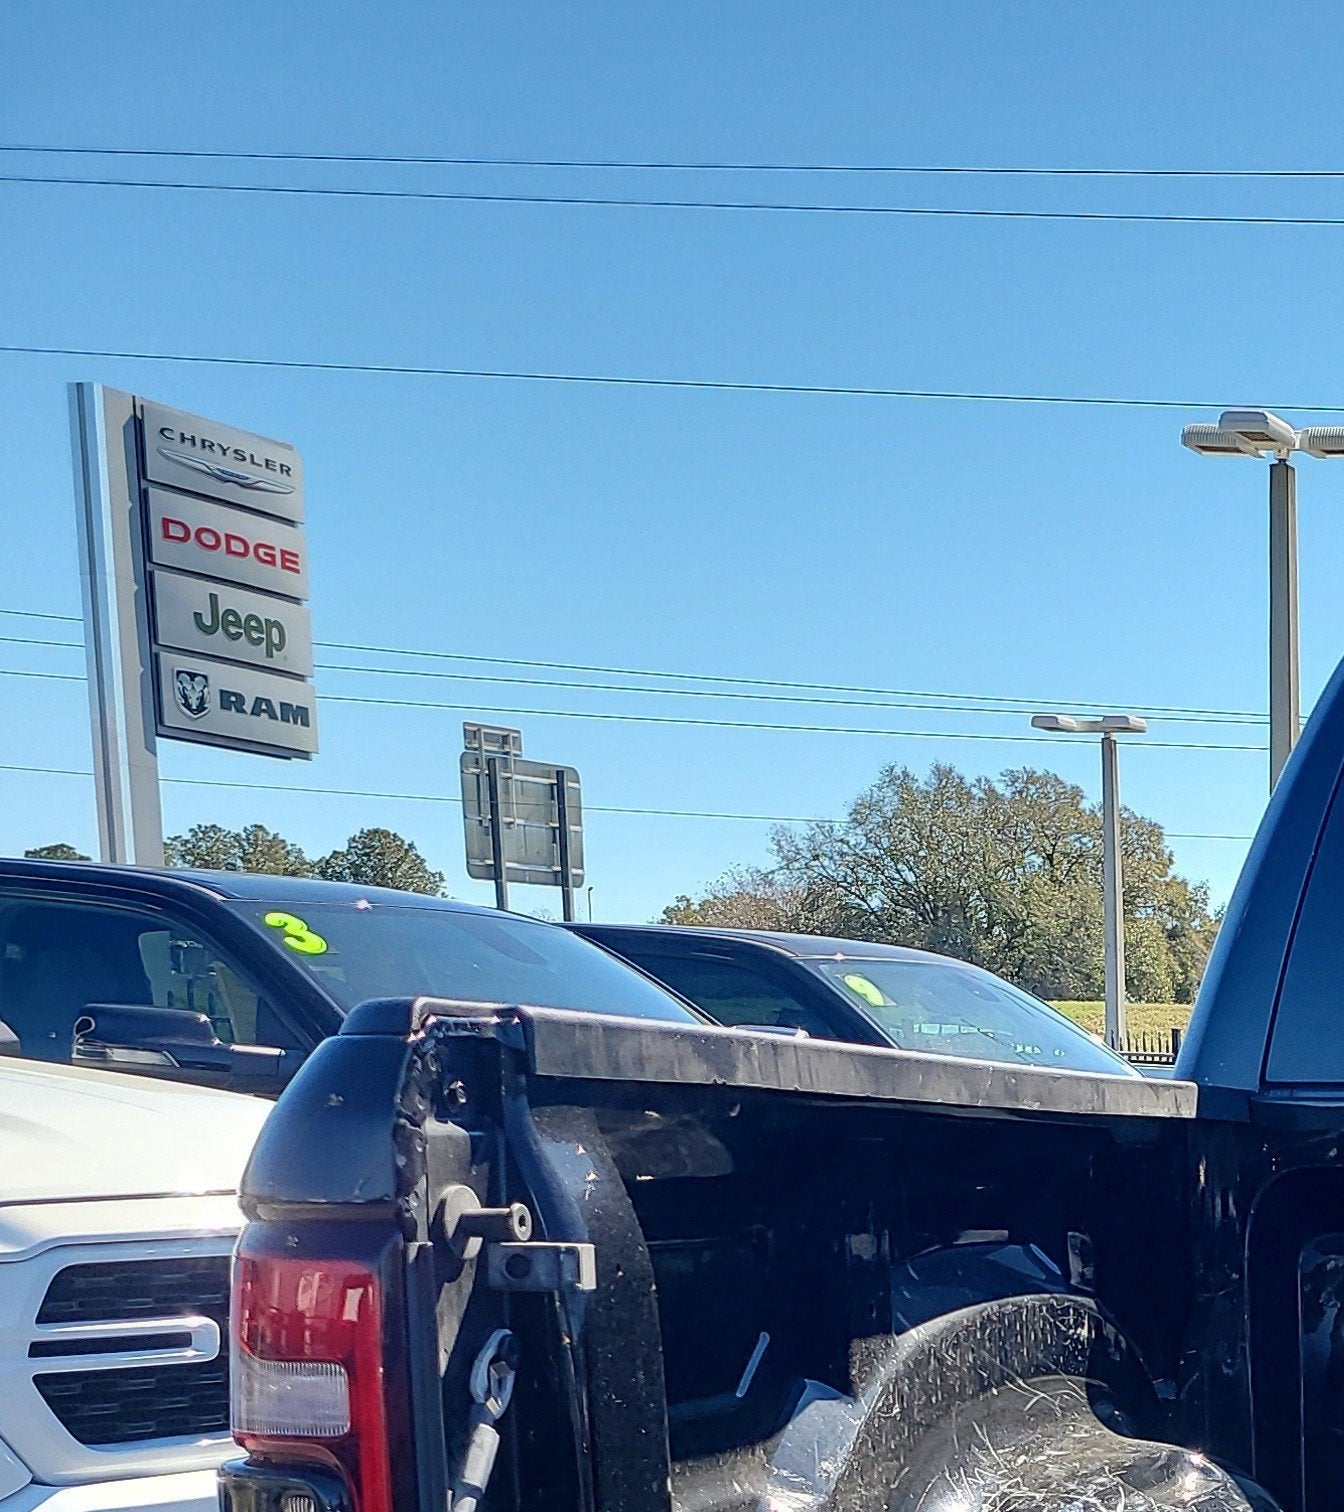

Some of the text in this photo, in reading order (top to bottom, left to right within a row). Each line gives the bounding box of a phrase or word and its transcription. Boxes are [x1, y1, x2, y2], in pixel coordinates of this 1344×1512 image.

[159, 427, 292, 477] CHRYSLER
[161, 516, 301, 575] DODGE
[193, 592, 286, 659] Jeep
[218, 688, 311, 728] RAM
[263, 910, 328, 955] 3
